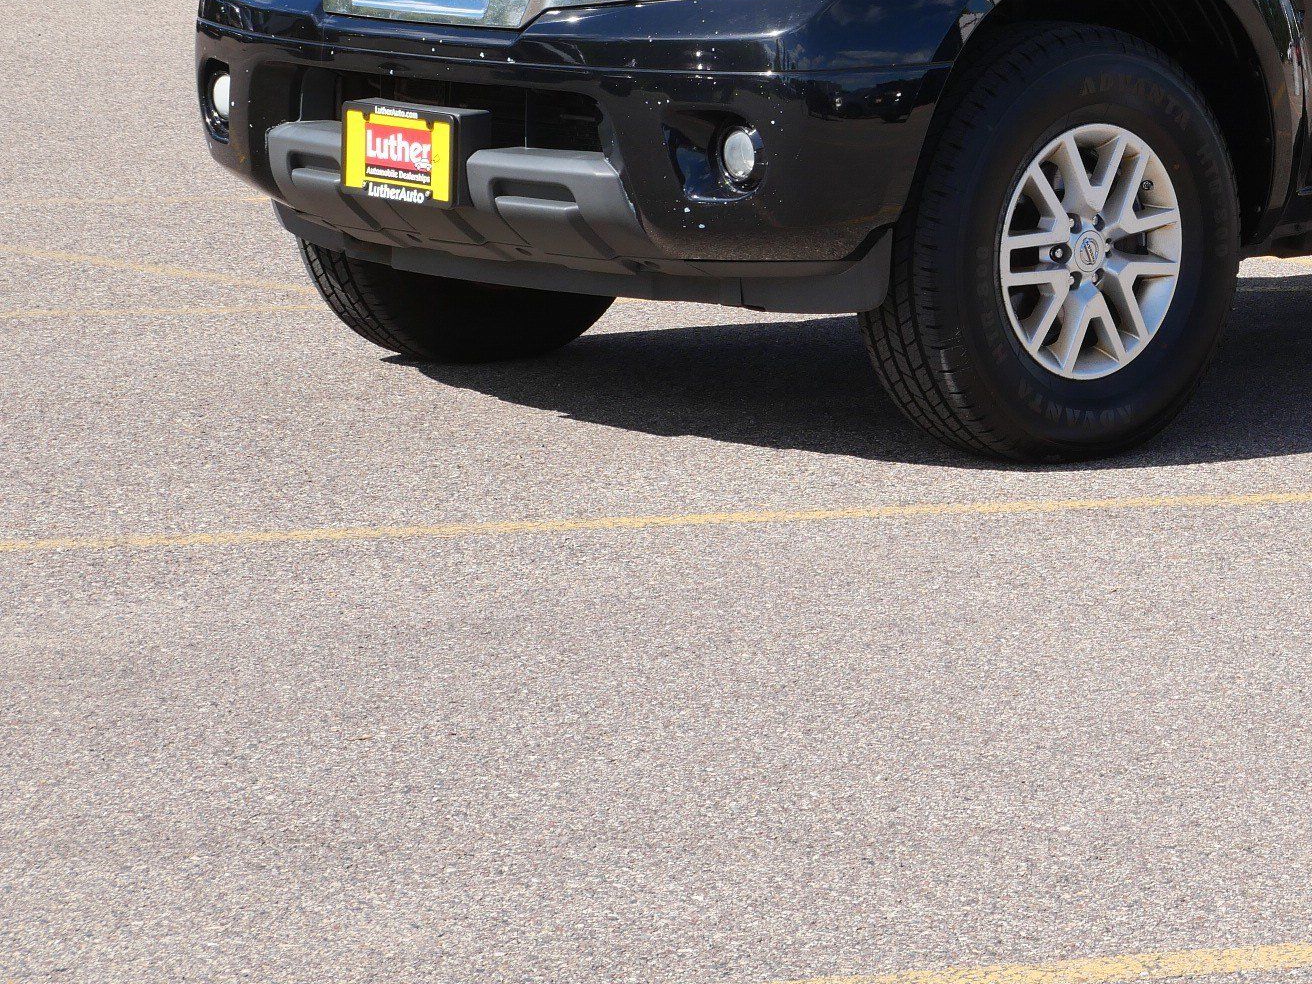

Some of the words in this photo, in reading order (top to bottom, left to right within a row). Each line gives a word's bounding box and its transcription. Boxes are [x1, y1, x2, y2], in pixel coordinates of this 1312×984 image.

[374, 105, 418, 119] LutherAuto.com
[1081, 71, 1191, 132] ADVANTA
[366, 129, 431, 165] Luther
[366, 166, 398, 178] Automobile
[399, 170, 431, 184] Dealerships
[367, 182, 425, 204] LutherAuto
[1017, 377, 1132, 428] ADVANTA
